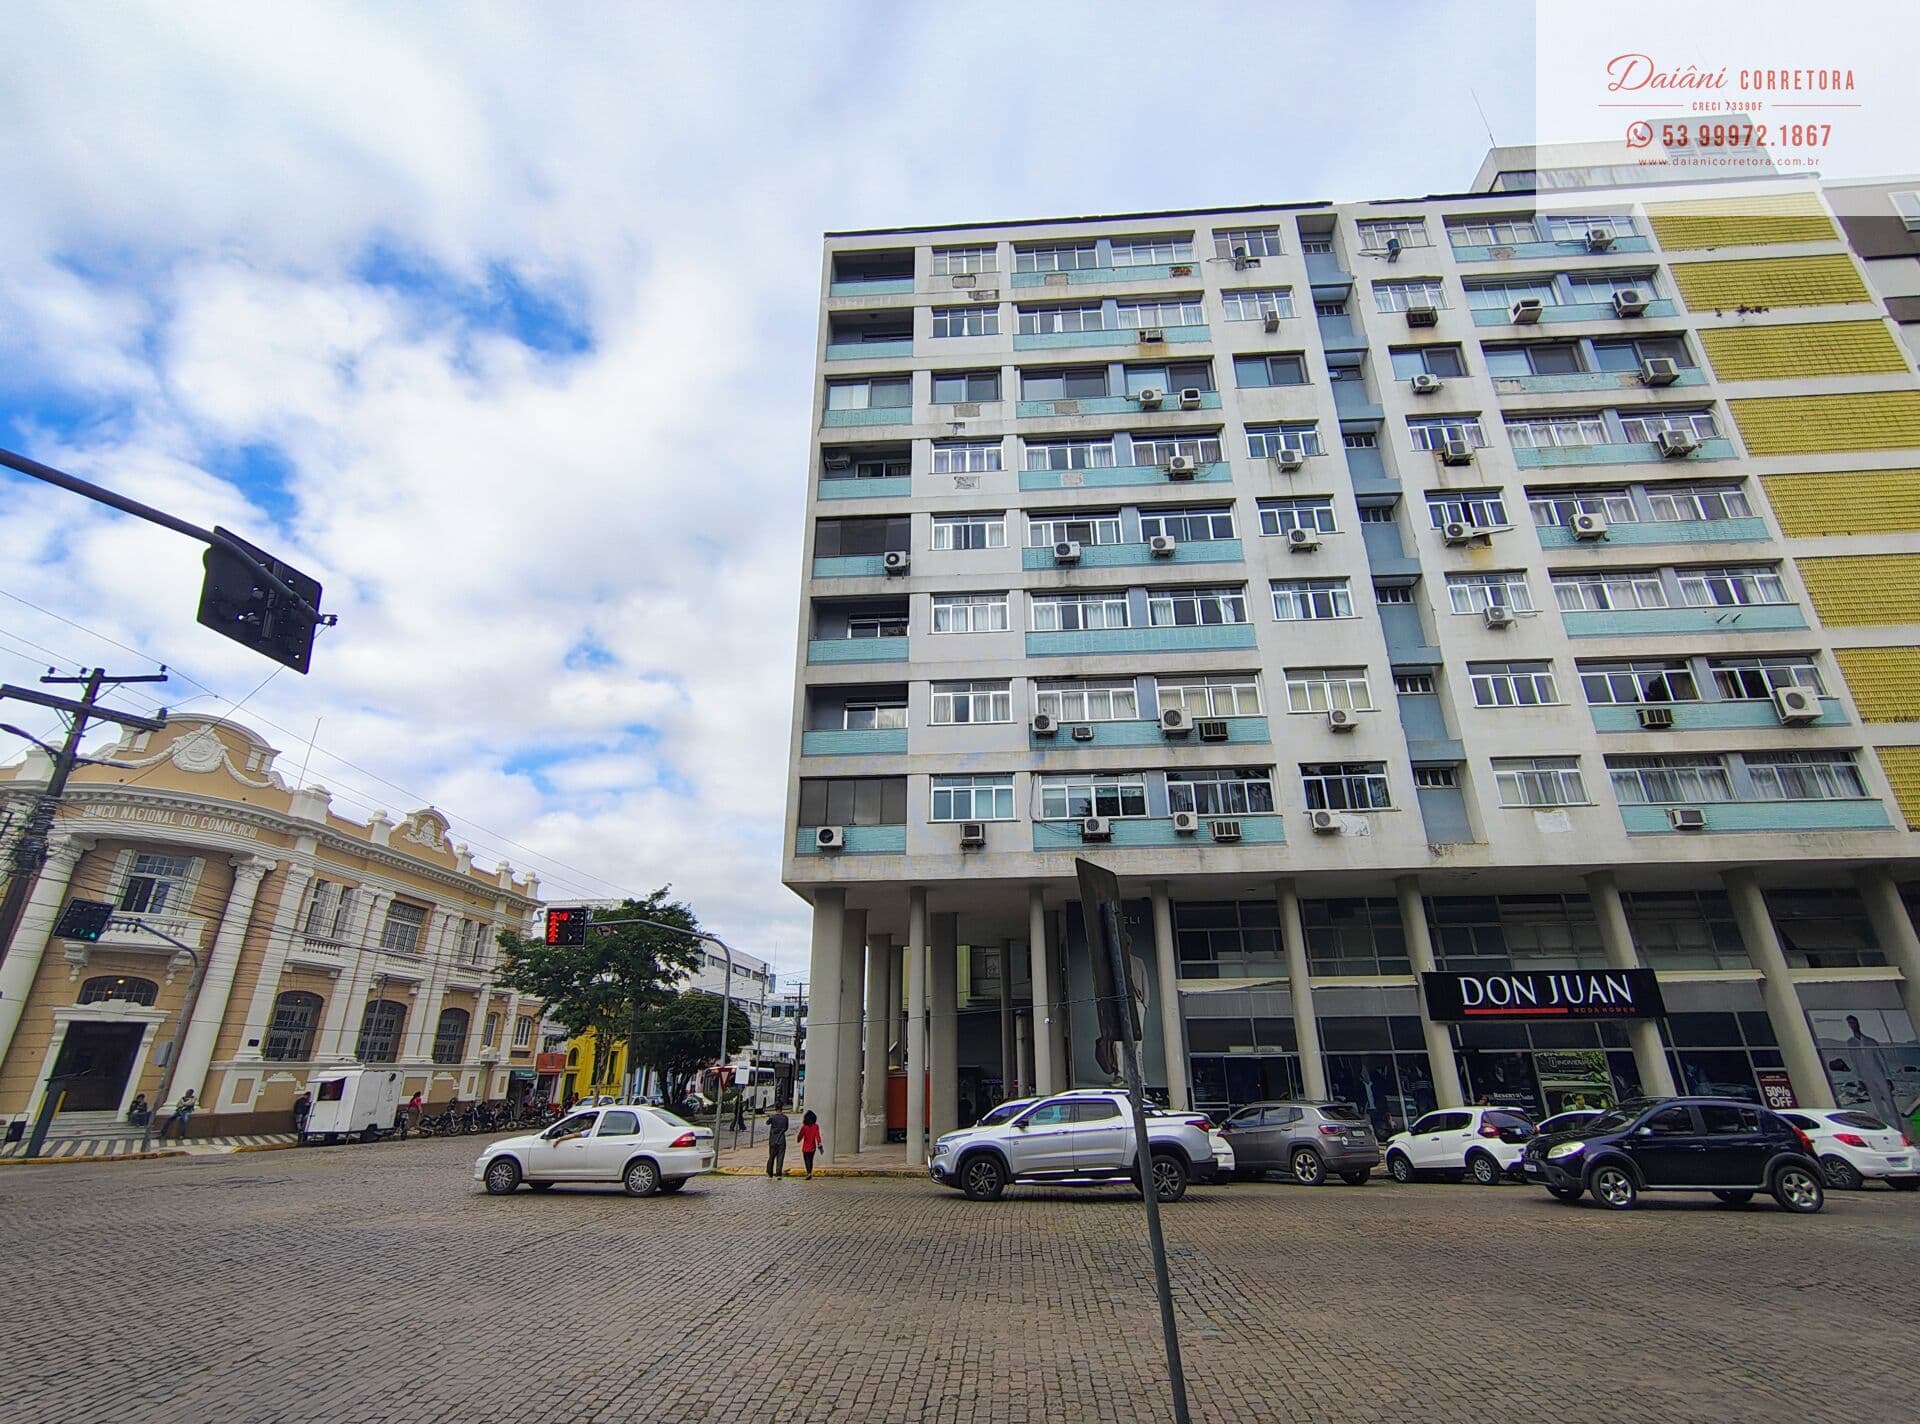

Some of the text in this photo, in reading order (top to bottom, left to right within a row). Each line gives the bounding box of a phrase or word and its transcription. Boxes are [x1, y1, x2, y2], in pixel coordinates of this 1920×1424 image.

[83, 804, 258, 839] BANCO NACIONAL DO COMMERCIO
[1456, 974, 1633, 1006] DON JUAN
[1764, 1085, 1792, 1097] 50%
[1770, 1096, 1793, 1107] OFF
